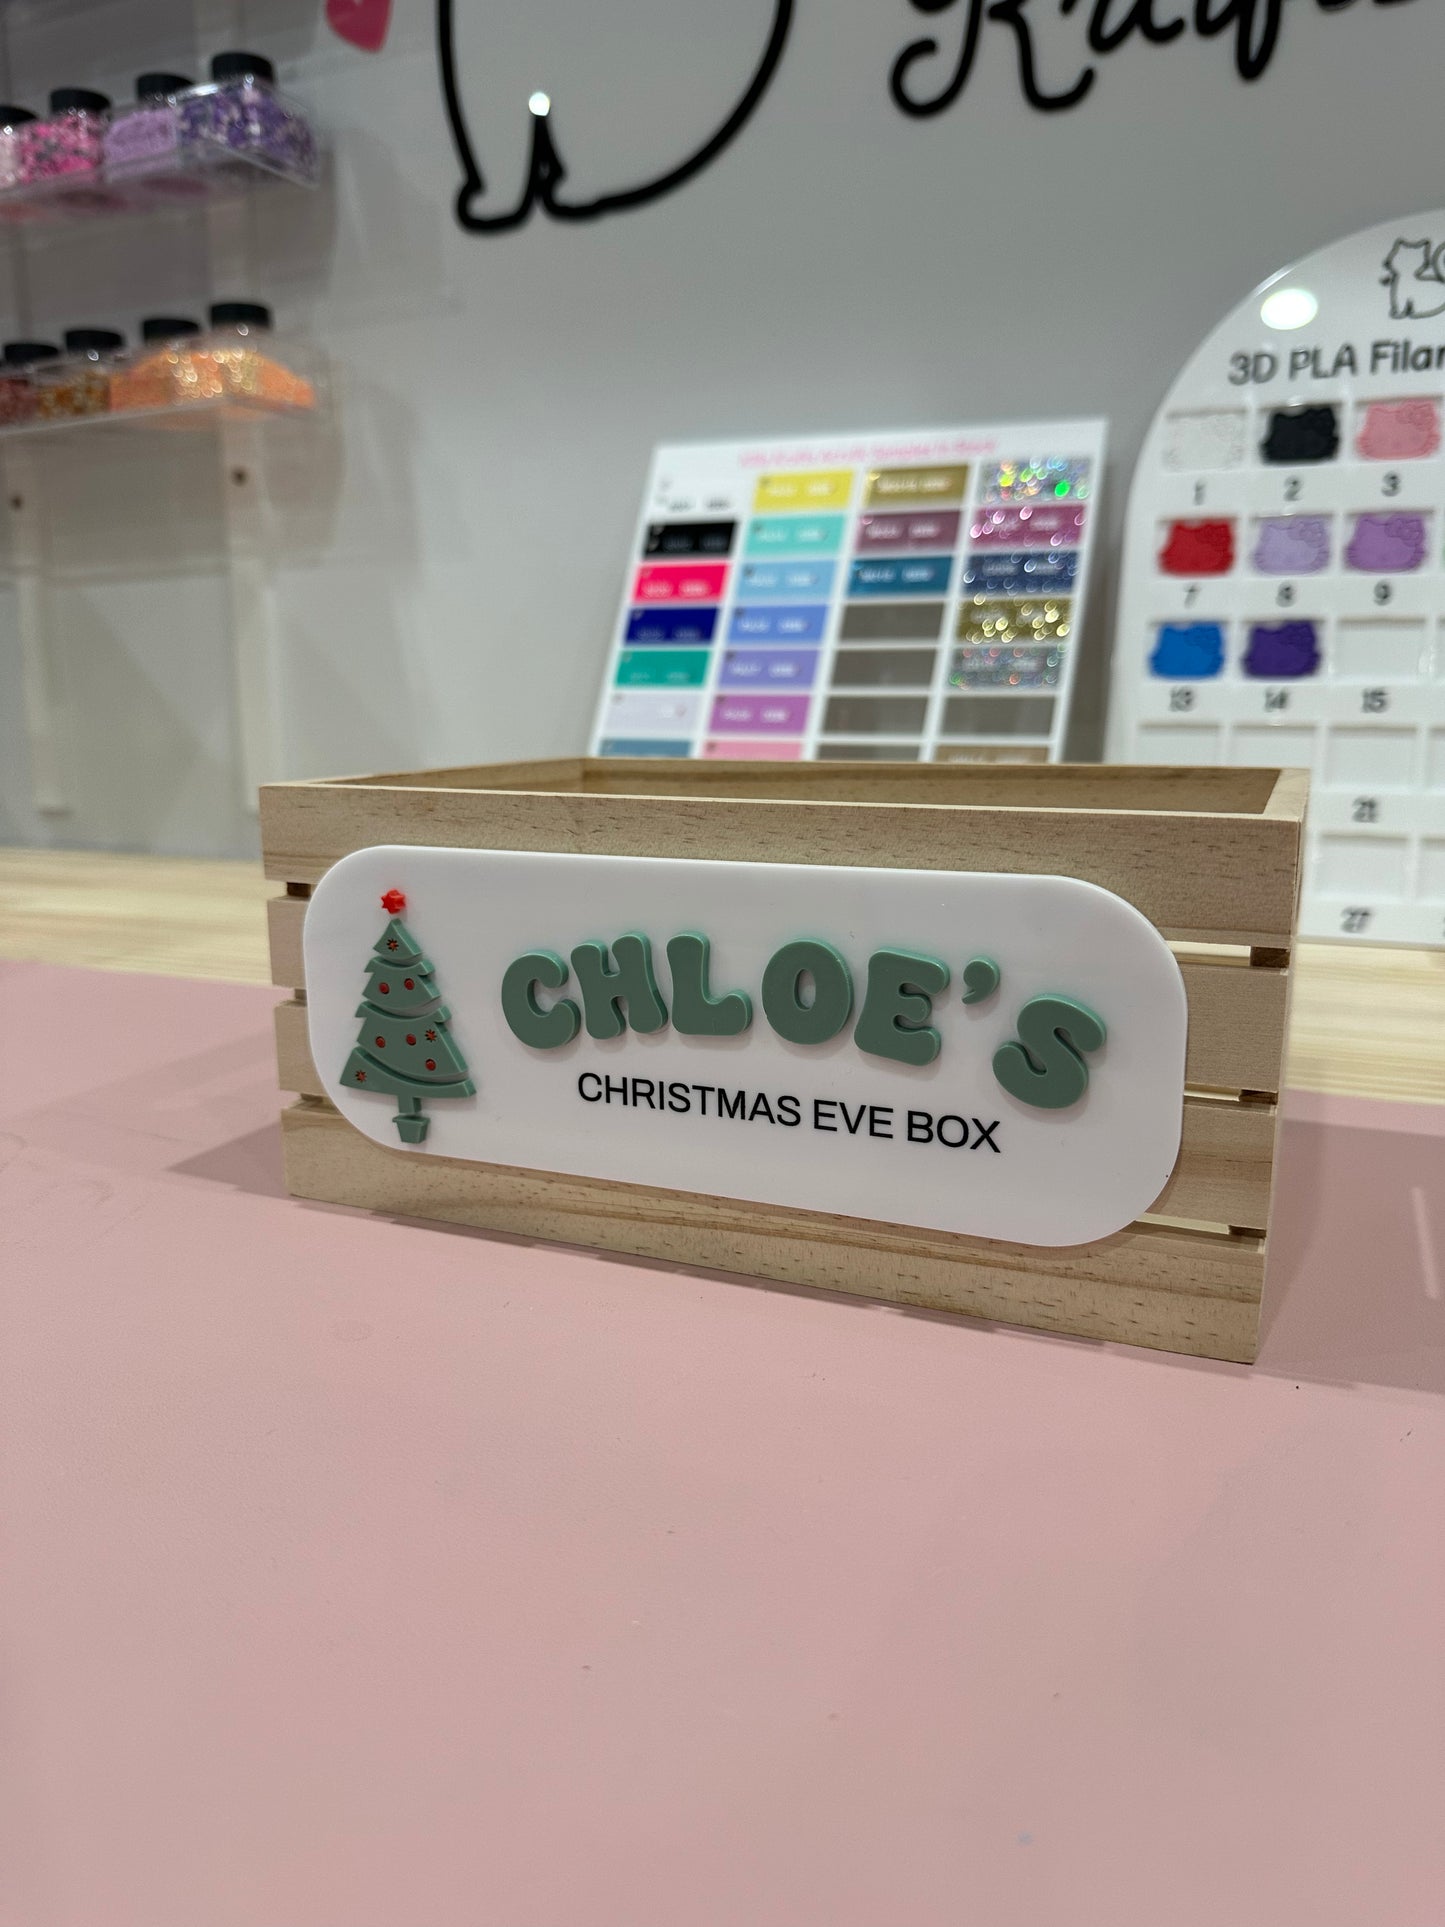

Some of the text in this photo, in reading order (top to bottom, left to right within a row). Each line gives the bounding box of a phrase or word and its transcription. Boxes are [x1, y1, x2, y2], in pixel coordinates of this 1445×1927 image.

[1228, 351, 1279, 386] 3D
[1288, 342, 1359, 381] PLA
[1283, 475, 1304, 503] 2
[1380, 471, 1402, 498] 3
[1183, 583, 1201, 610] 7
[1373, 580, 1393, 606] 9
[1361, 685, 1389, 714] 15
[577, 1071, 1002, 1154] CHRISTMAS EVE BOX
